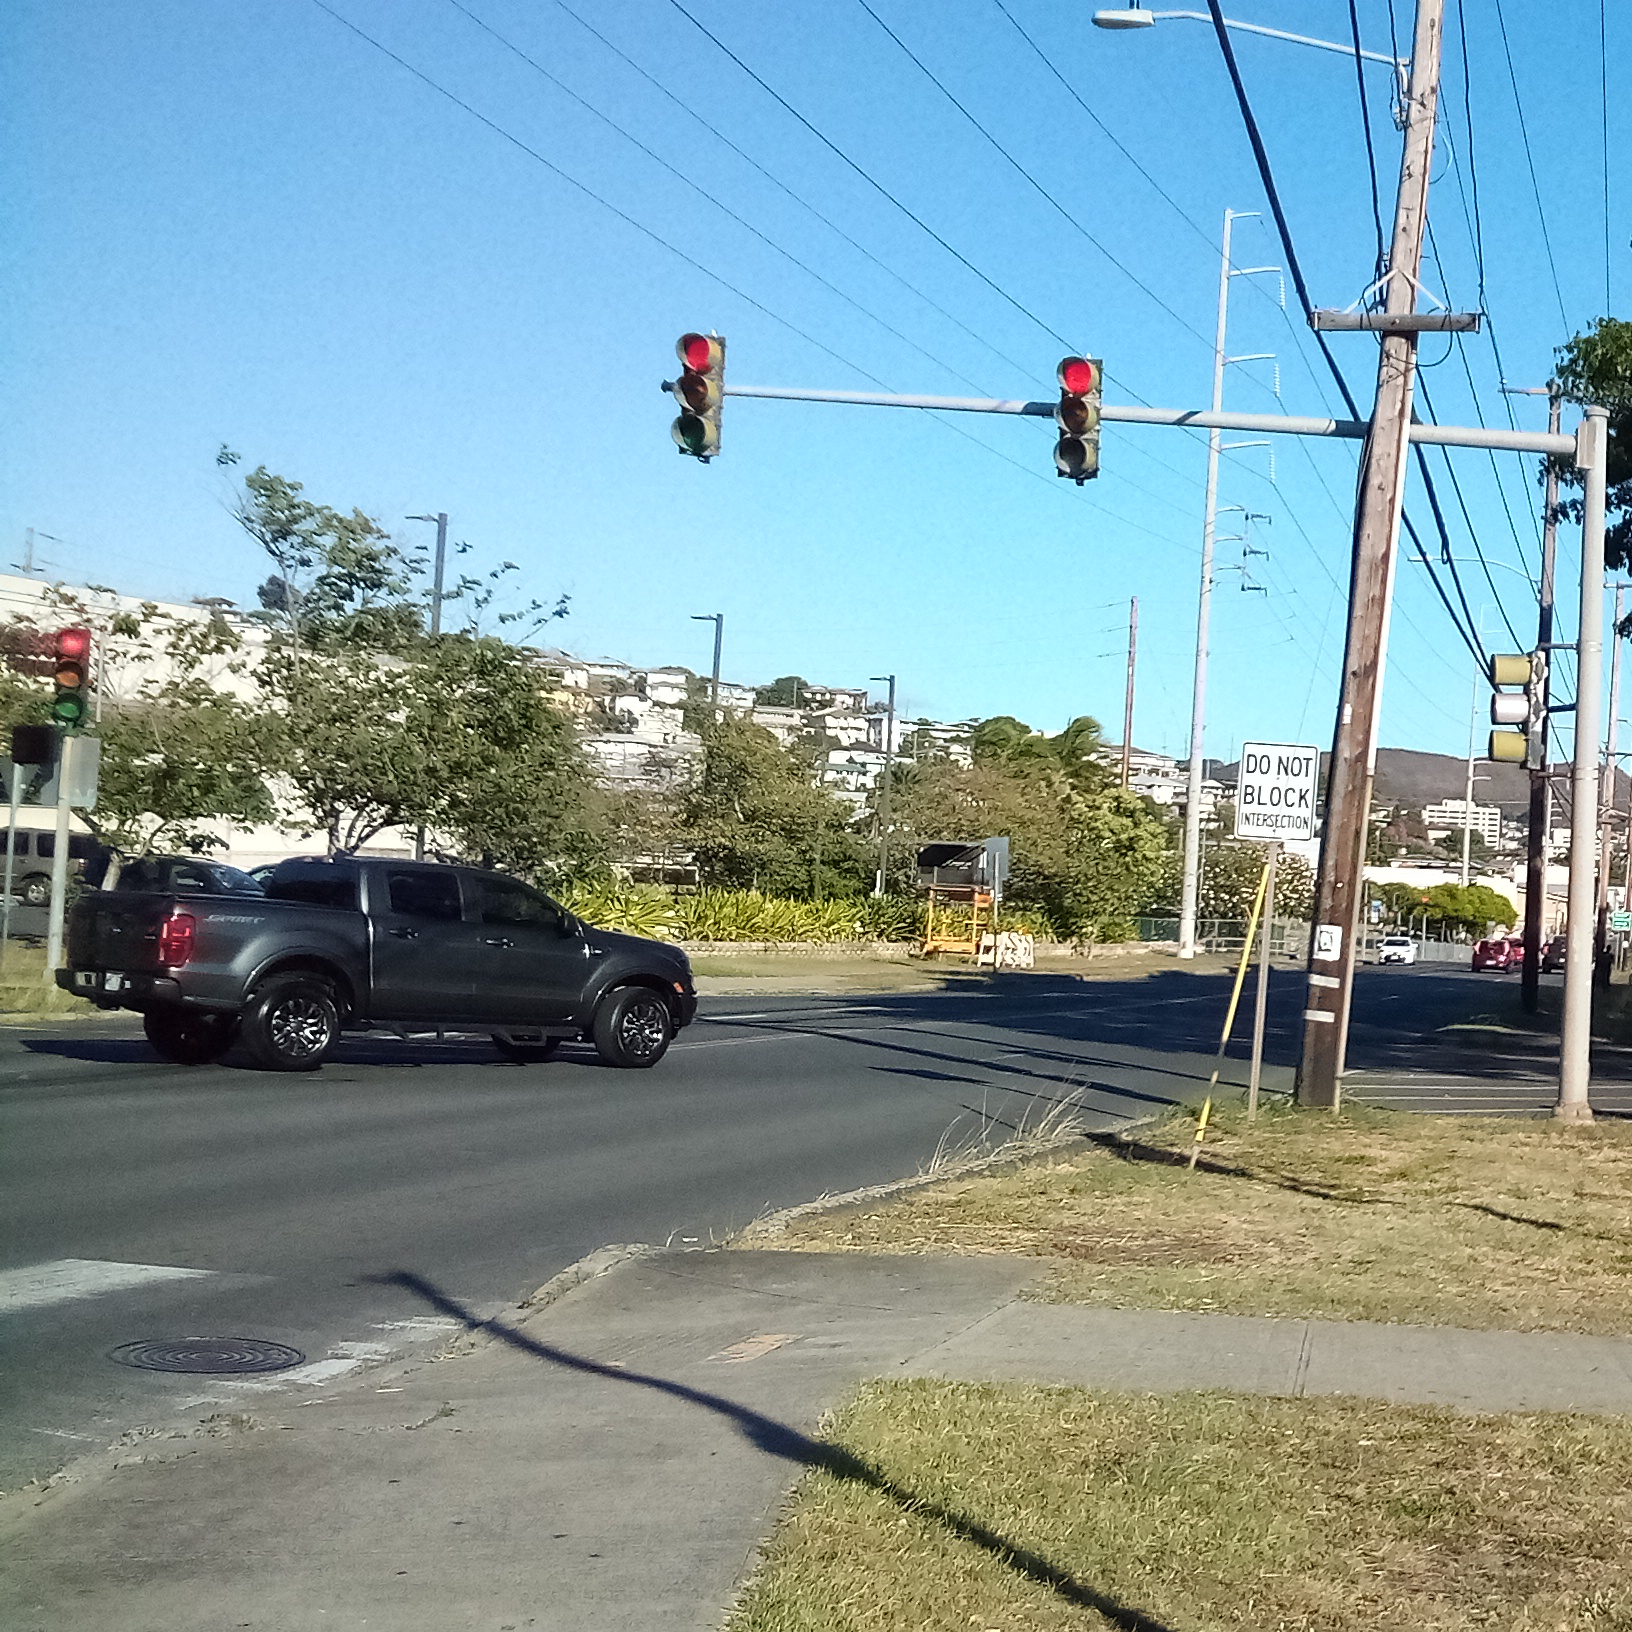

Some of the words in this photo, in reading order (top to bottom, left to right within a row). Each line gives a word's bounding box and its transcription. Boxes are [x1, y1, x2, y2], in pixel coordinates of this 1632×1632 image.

[1246, 753, 1271, 775] DO
[1277, 755, 1313, 778] NOT
[1243, 784, 1310, 809] BLOCK
[1241, 812, 1310, 830] INTERSECTION
